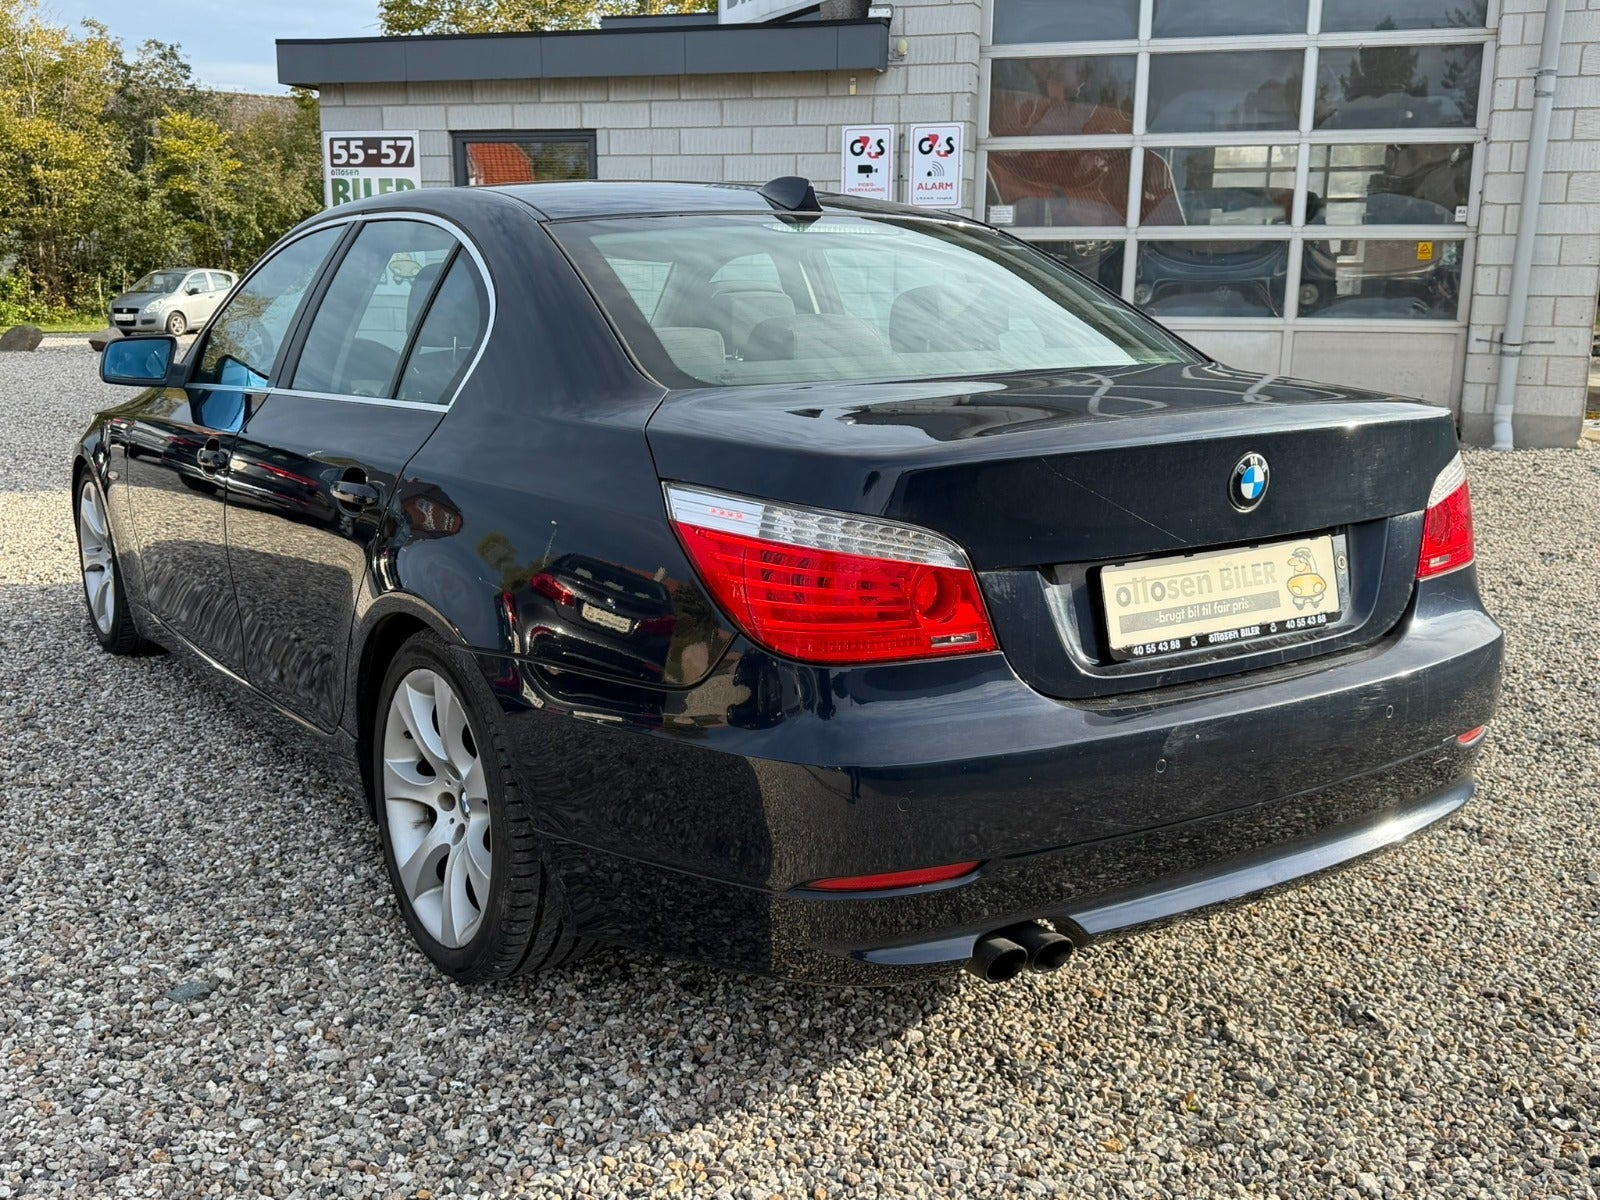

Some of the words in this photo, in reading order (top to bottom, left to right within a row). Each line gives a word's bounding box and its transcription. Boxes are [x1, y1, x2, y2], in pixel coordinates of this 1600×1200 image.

[333, 140, 412, 165] 55-57
[917, 182, 953, 191] ALARM
[1238, 456, 1268, 475] BMW
[1115, 570, 1213, 607] ottosen
[1219, 561, 1278, 592] BILER
[1155, 608, 1185, 623] -brugt
[1187, 605, 1200, 618] bil
[1202, 603, 1212, 616] til
[1213, 601, 1230, 614] fair
[1232, 598, 1249, 614] pris
[1133, 646, 1144, 656] 40
[1146, 643, 1157, 654] 55
[1158, 641, 1169, 652] 43
[1170, 639, 1181, 649] 88
[1240, 626, 1261, 638] BILER
[1286, 620, 1296, 630] 40
[1297, 618, 1306, 628] 55
[1307, 616, 1316, 626] 43
[1317, 614, 1327, 624] 88
